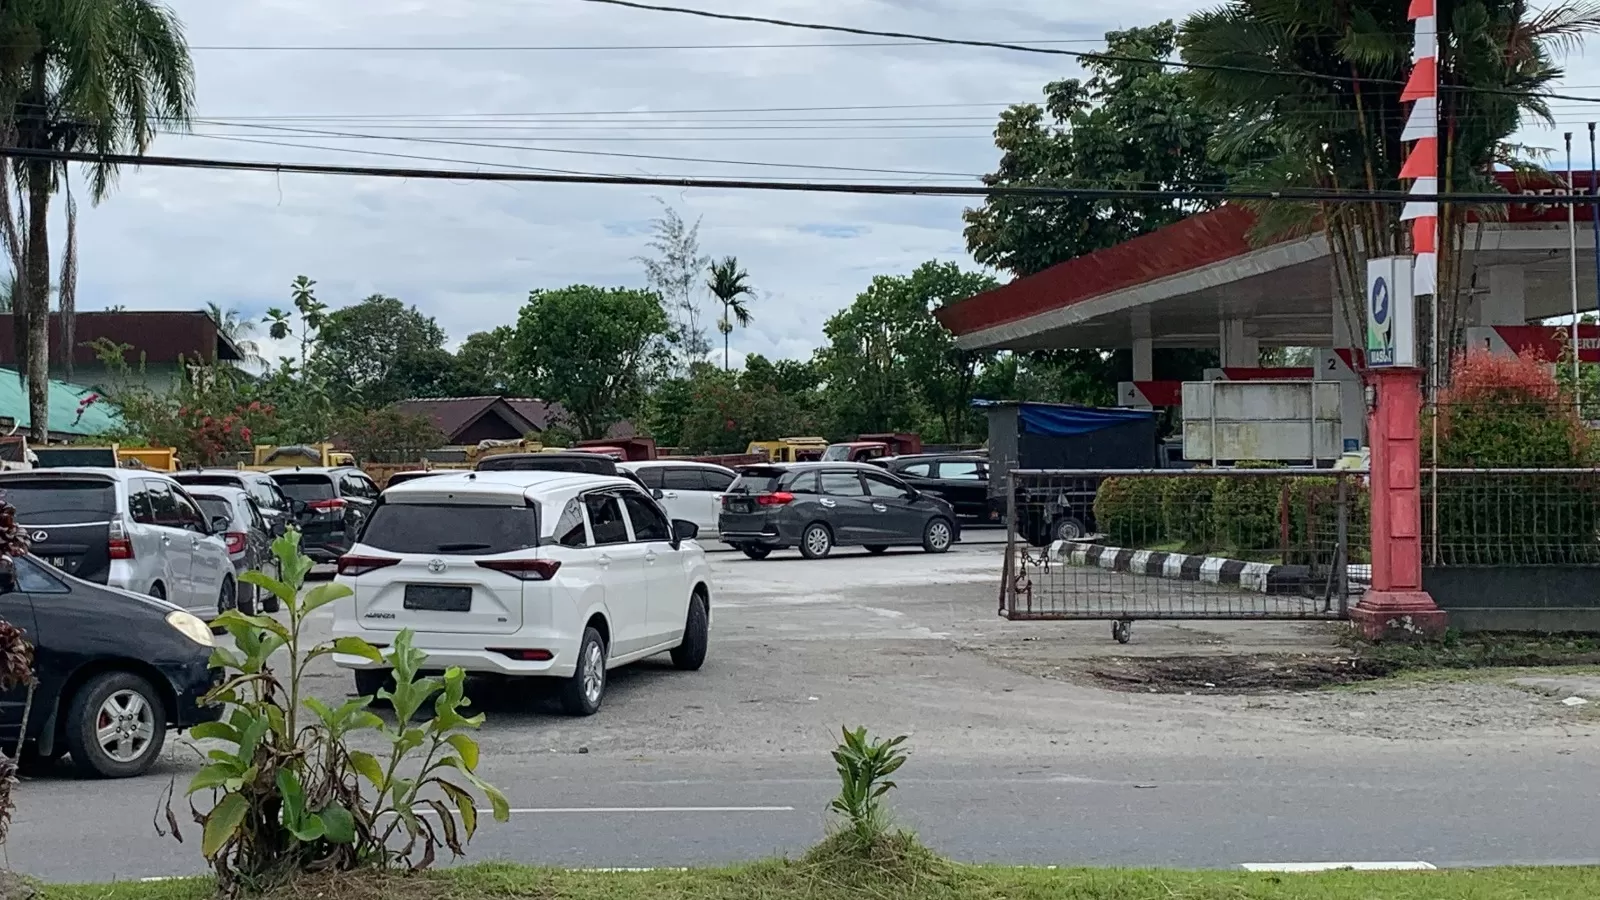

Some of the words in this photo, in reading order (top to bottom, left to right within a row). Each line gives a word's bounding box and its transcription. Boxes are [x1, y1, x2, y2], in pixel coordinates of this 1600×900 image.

[1522, 186, 1600, 209] PERT
[1327, 359, 1337, 370] 2
[1127, 388, 1136, 398] 4
